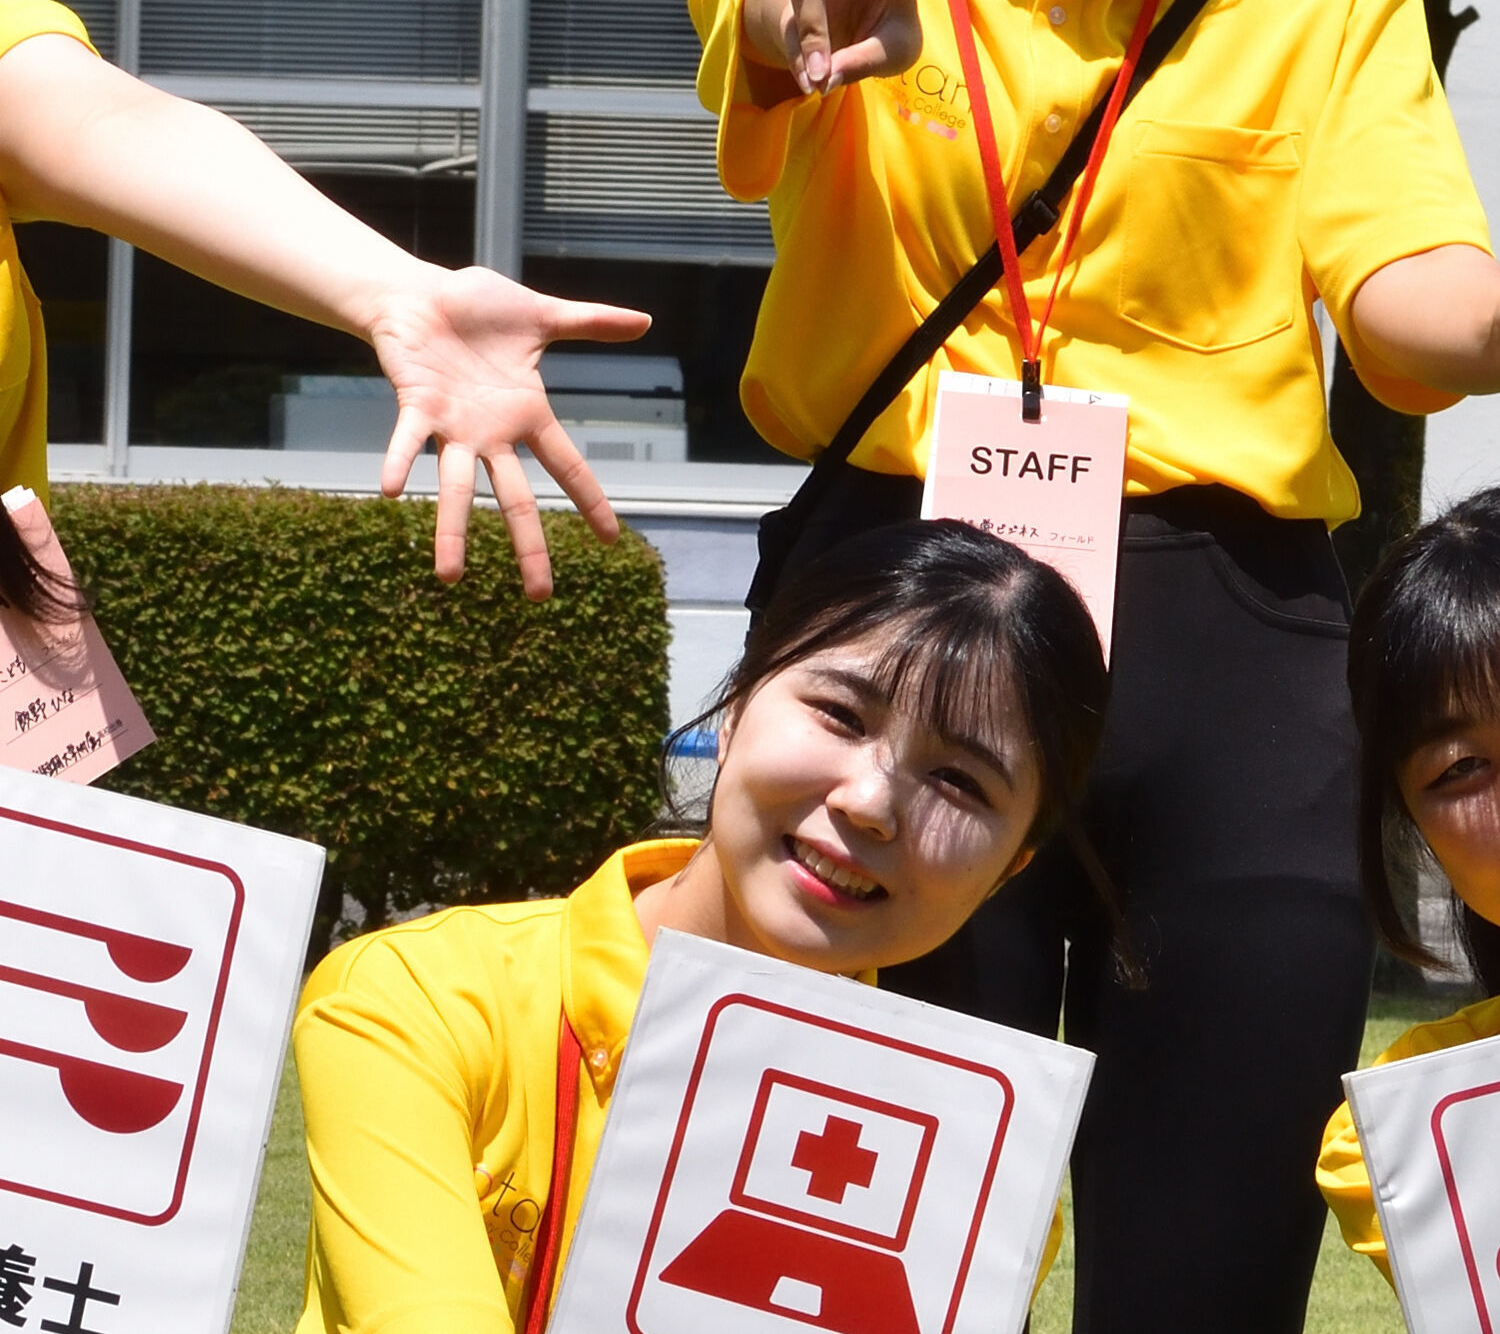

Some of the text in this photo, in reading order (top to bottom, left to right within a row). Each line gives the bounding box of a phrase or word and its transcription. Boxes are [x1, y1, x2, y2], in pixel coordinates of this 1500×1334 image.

[970, 446, 1092, 483] STAFF
[1050, 532, 1096, 545] フィールド
